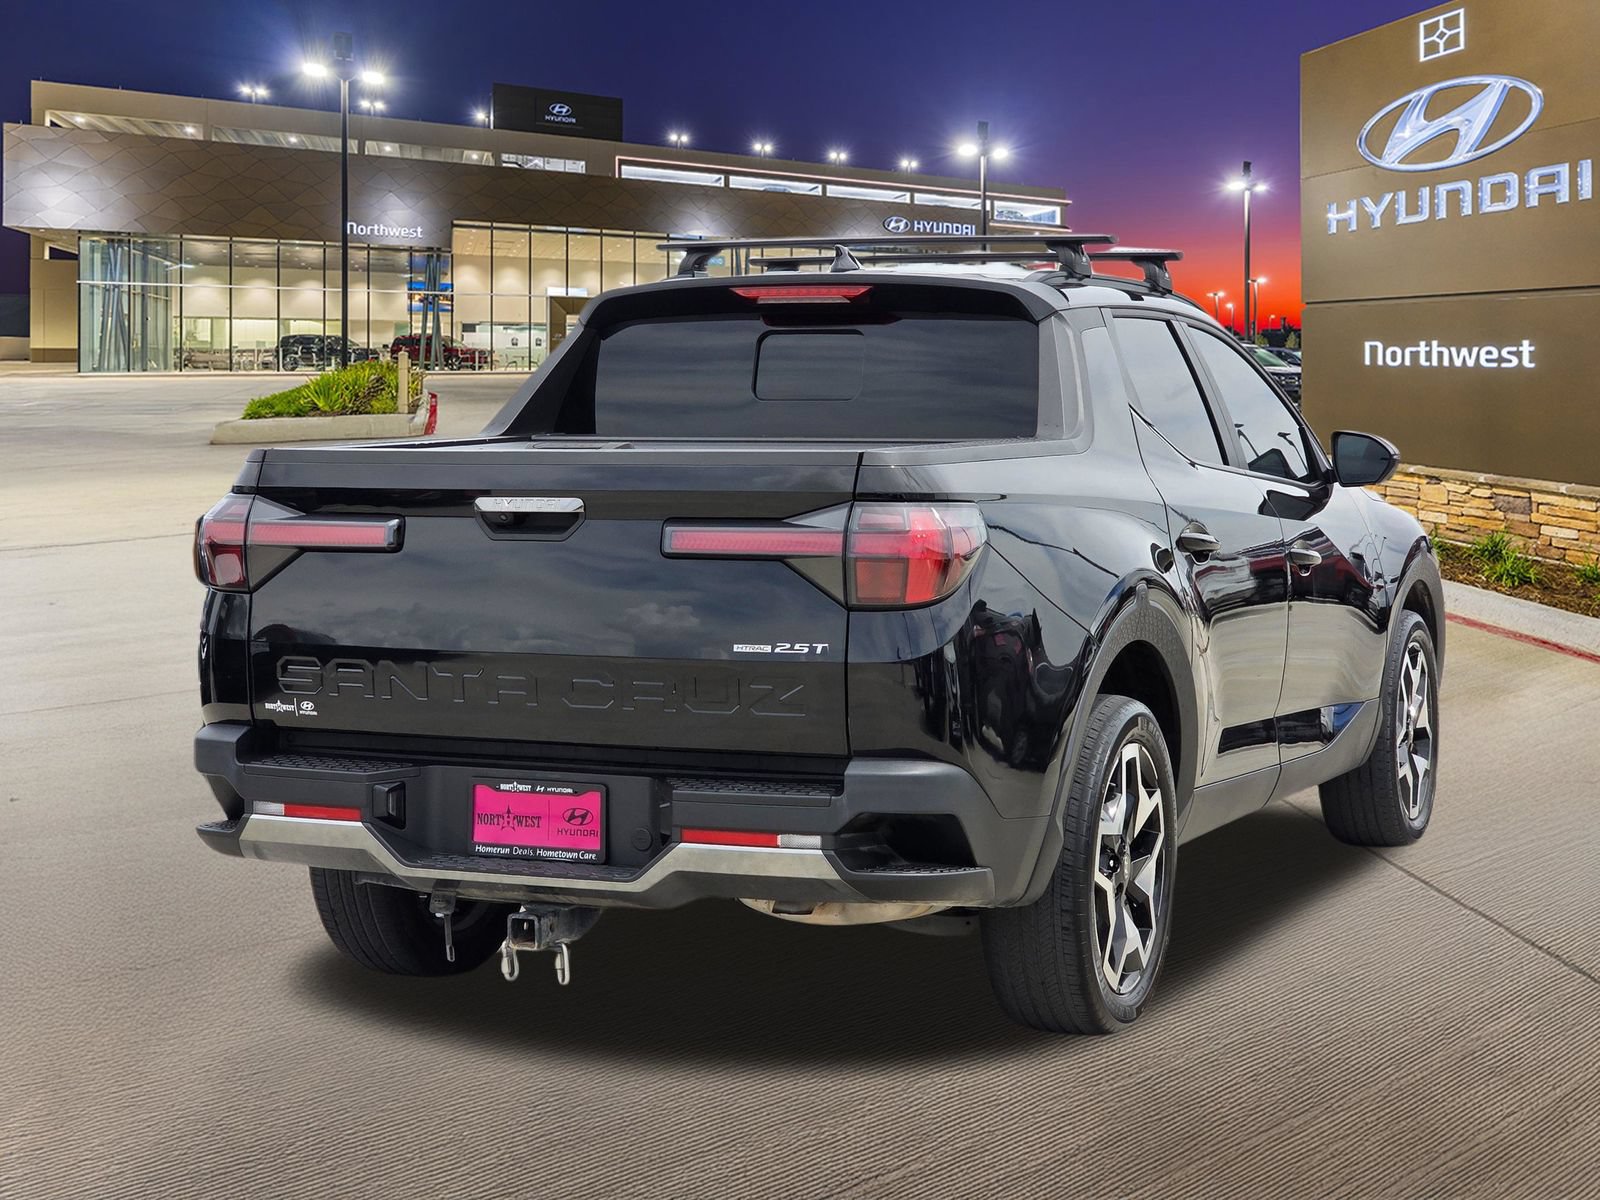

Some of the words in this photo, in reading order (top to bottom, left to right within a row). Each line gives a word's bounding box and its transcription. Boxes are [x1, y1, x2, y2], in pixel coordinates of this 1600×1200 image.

[1326, 159, 1593, 235] HYUNDAI
[347, 221, 424, 238] Northwest
[914, 220, 976, 236] HYUNDAI
[1363, 339, 1537, 368] Northwest
[735, 645, 770, 653] HTRAC
[275, 655, 539, 707] SANTA
[560, 670, 806, 717] CRUZ
[557, 828, 598, 837] HYUNDAI
[475, 844, 510, 855] Homerun
[536, 849, 578, 860] Hometown
